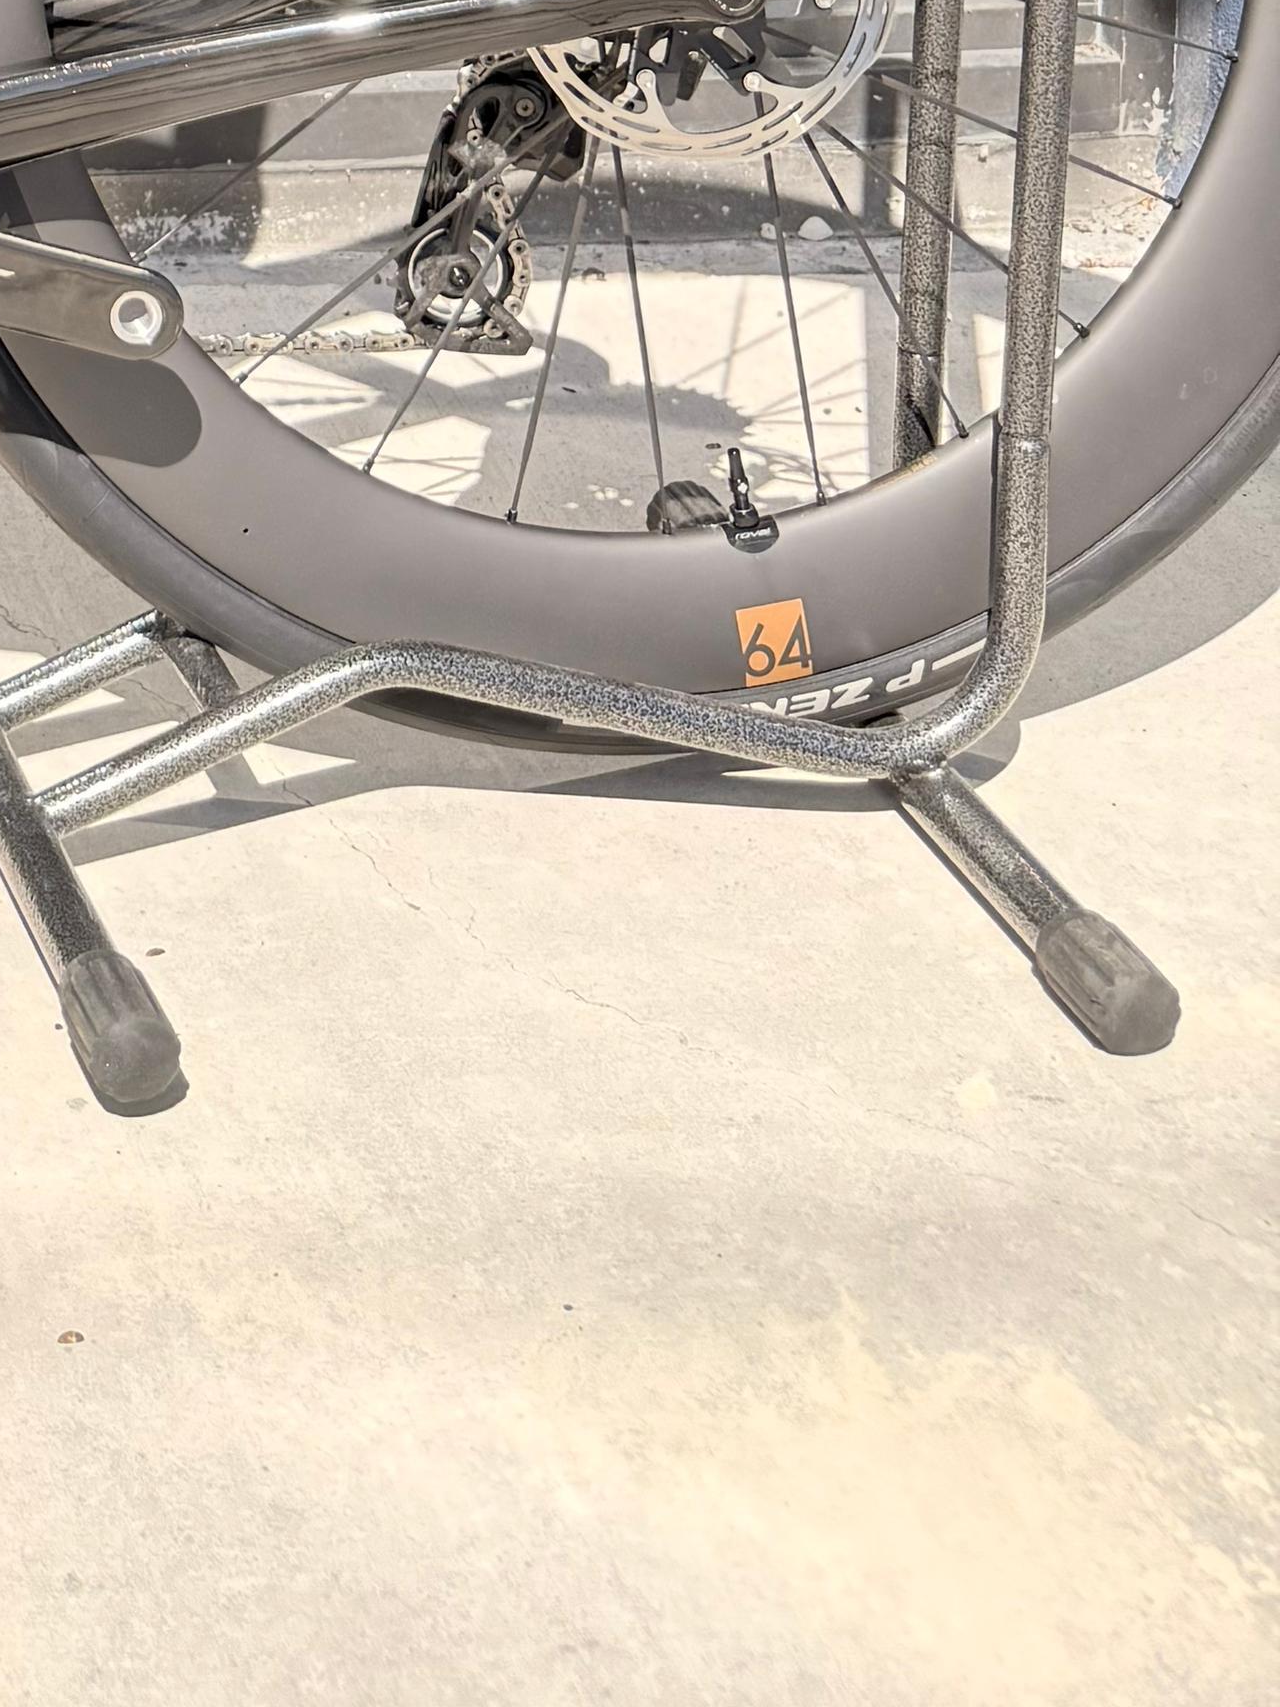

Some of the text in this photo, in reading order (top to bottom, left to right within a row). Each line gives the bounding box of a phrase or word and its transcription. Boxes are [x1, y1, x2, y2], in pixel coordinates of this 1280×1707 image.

[734, 526, 772, 540] roval
[743, 613, 811, 678] 64
[885, 658, 927, 694] P
